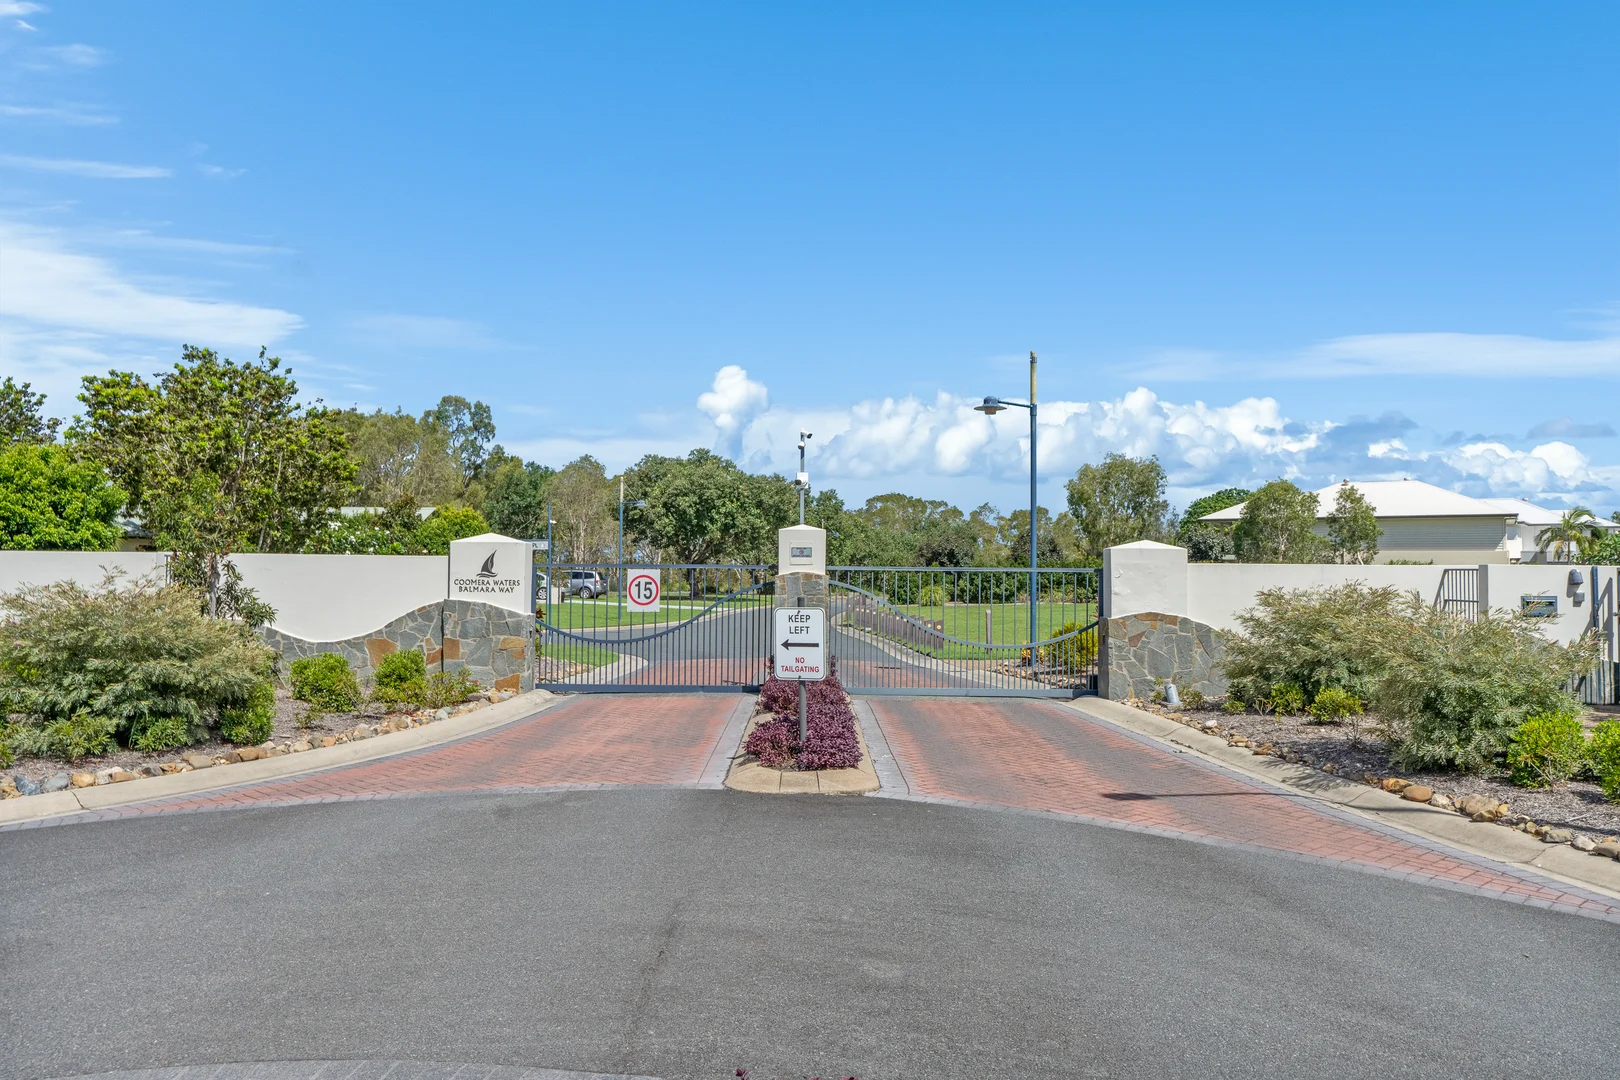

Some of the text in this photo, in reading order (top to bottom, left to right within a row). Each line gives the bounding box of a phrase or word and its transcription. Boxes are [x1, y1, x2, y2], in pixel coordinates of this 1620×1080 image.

[634, 580, 652, 600] 15
[788, 614, 811, 623] KEEP
[789, 626, 810, 634] LEFT
